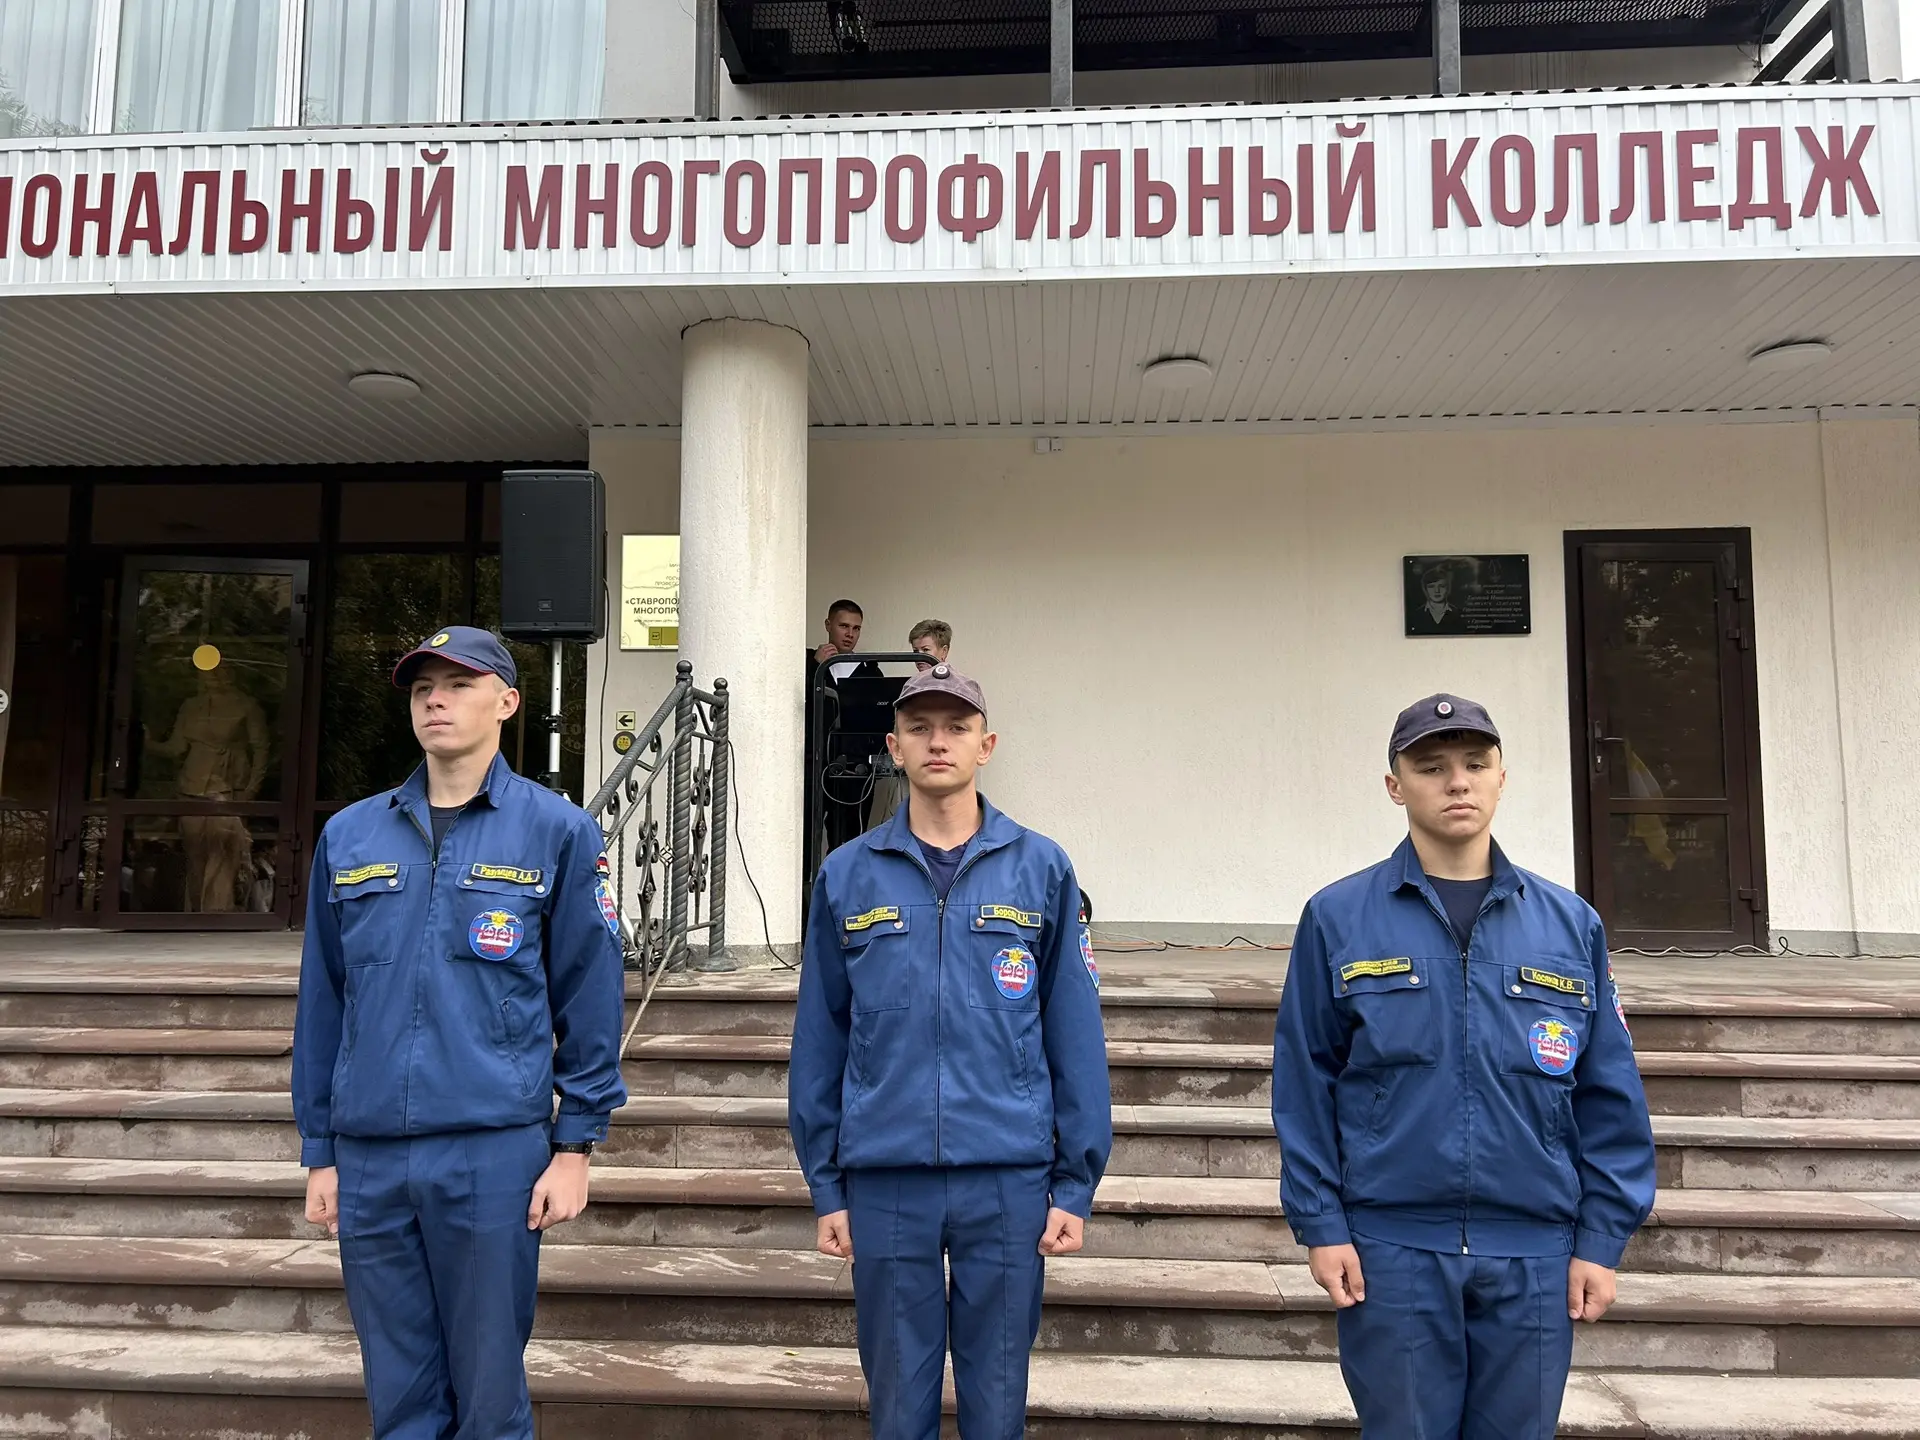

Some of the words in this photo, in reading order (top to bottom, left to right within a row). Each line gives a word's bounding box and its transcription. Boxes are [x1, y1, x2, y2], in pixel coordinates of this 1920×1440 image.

[0, 150, 453, 258] ОНАЛЬНЫЙ
[506, 125, 1374, 248] МНОГОПРОФИЛЬНЫЙ
[1432, 127, 1878, 229] КОЛЛЕДЖ
